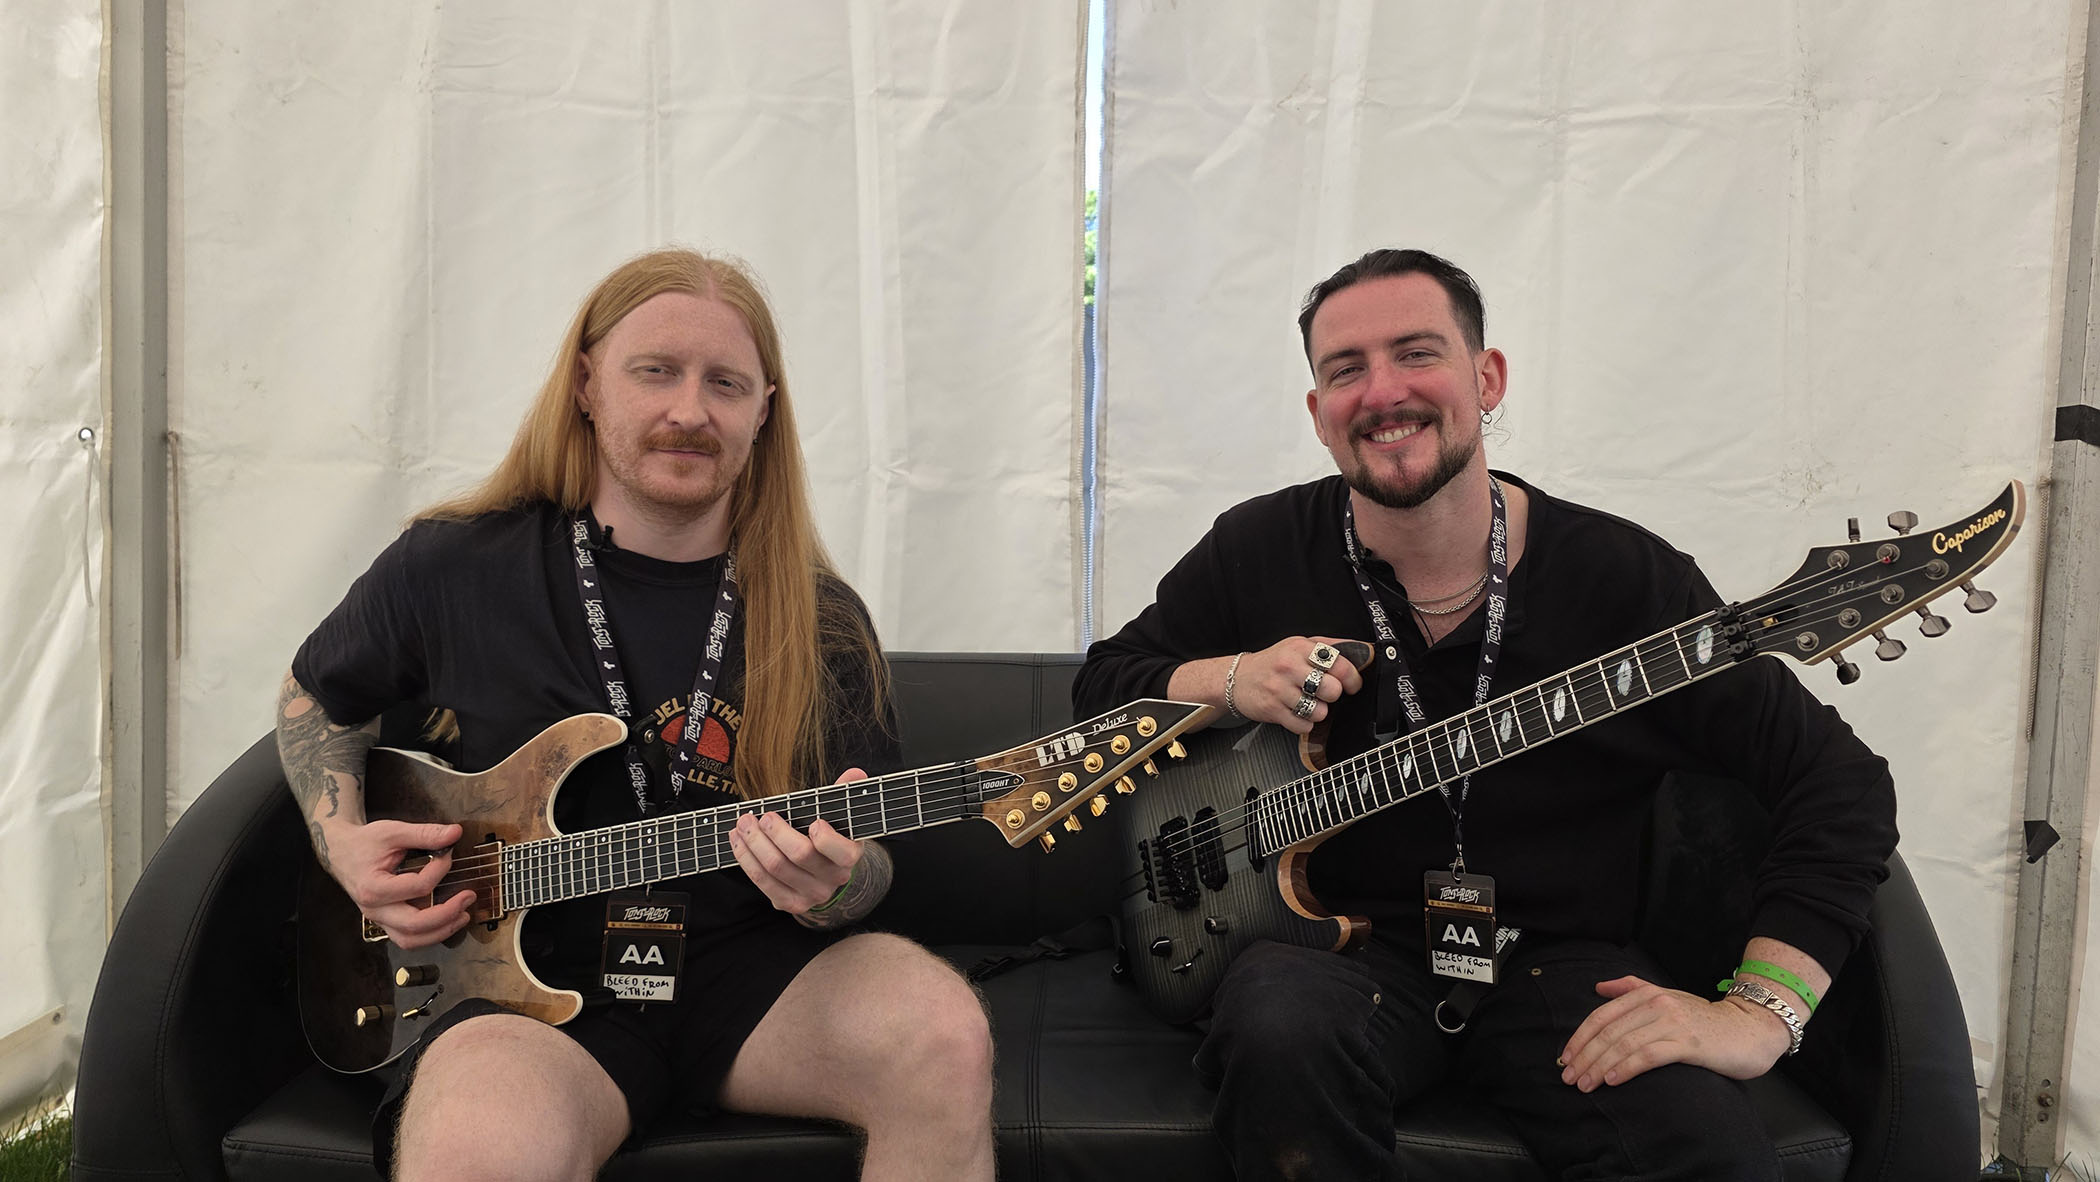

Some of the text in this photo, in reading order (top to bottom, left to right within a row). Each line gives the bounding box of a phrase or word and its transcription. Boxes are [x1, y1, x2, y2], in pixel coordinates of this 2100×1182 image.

[1932, 508, 2006, 555] Caparison
[712, 697, 742, 731] THE
[1035, 712, 1128, 767] LTD Deluxe
[1441, 923, 1480, 947] AA
[619, 944, 664, 965] AA
[1434, 951, 1491, 968] BLEED FROM
[1436, 964, 1474, 975] WITHIN
[606, 975, 669, 988] BLEED FROM
